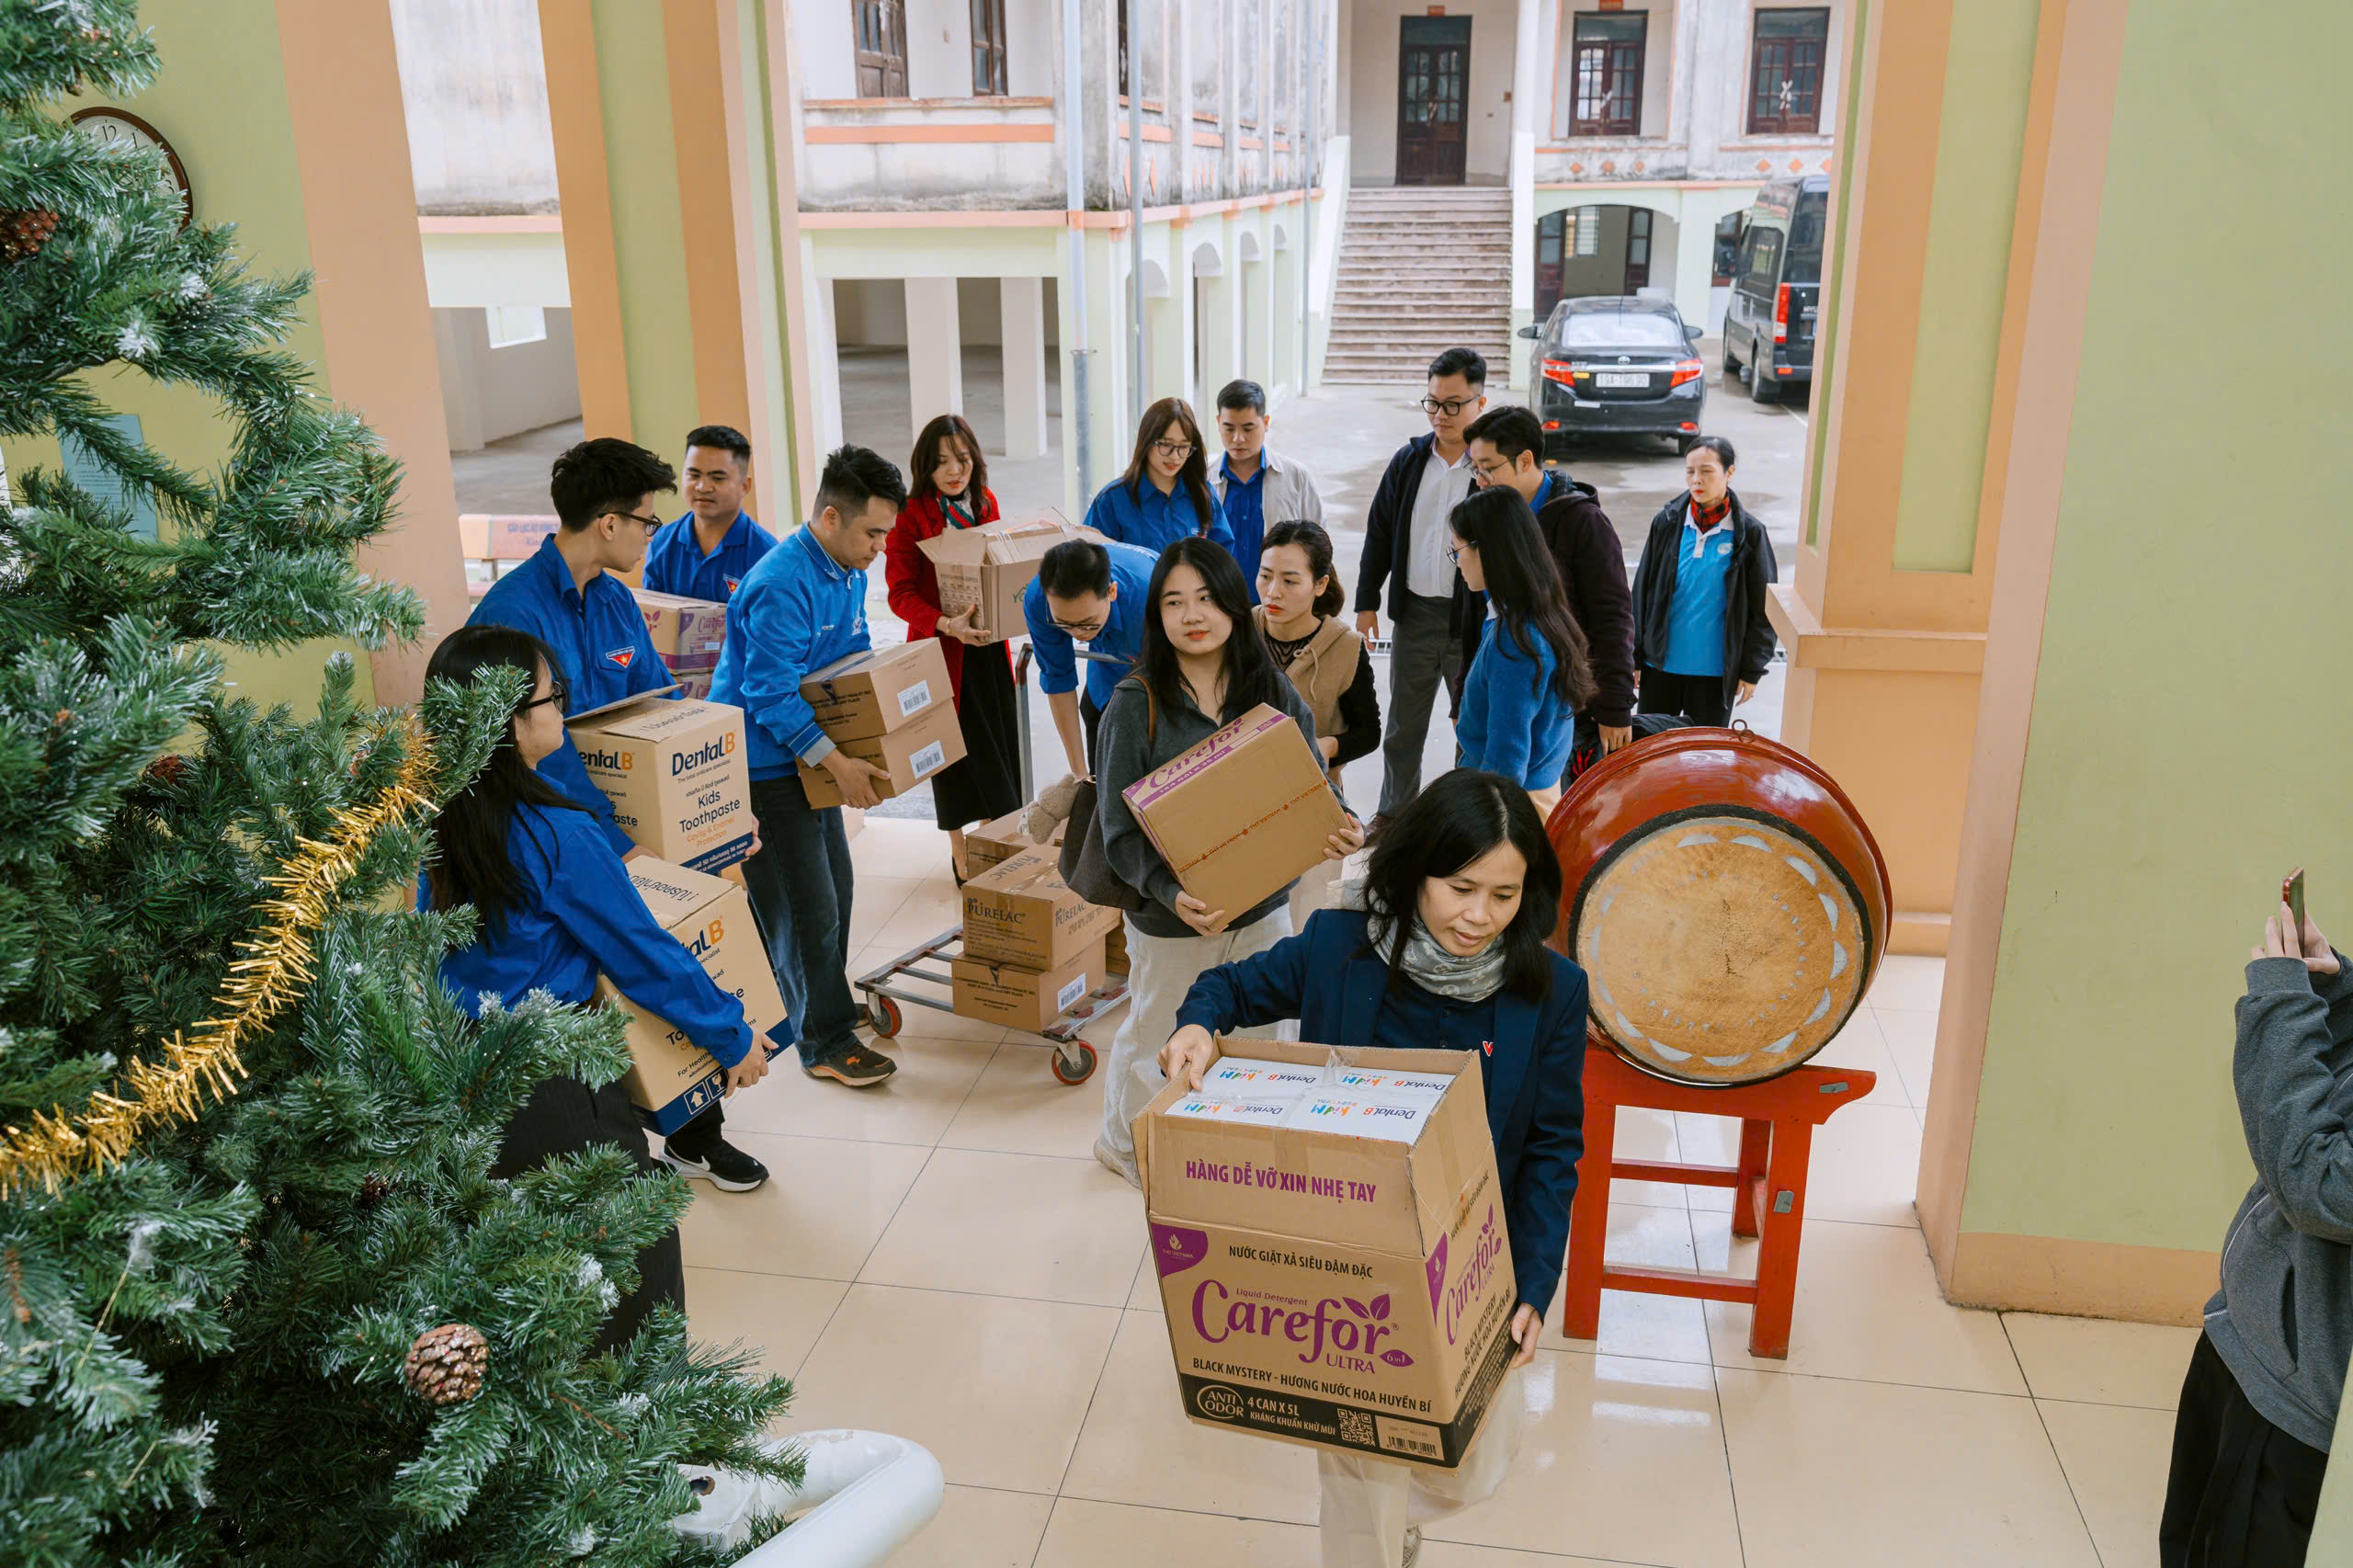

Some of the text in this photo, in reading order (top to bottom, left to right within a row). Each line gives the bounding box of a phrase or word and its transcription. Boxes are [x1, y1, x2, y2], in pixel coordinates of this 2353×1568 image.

[578, 749, 633, 770] entalB
[1150, 722, 1244, 789] Carefor
[698, 790, 721, 810] Kids
[679, 799, 741, 833] Toothpaste
[697, 830, 727, 847] Protection
[699, 948, 721, 965] pecialist
[676, 1066, 688, 1078] For
[689, 1051, 711, 1069] Health
[1186, 1159, 1377, 1203] HÀNG DỄ VỠ XIN NHẸ TAY
[1229, 1245, 1373, 1279] NƯỚC GIẶT XẢ SIÊU ĐẬM ĐẶC
[1236, 1288, 1308, 1307] Liquid Detergent
[1192, 1279, 1391, 1363] Carefor
[1325, 1352, 1376, 1374] ULTRA
[1192, 1358, 1224, 1374] BLACK
[1225, 1363, 1272, 1382] MYSTERY
[1280, 1374, 1319, 1392] HƯƠNG
[1322, 1380, 1351, 1398] NƯỚC
[1353, 1388, 1377, 1403] HOA
[1379, 1391, 1416, 1410] HUYỀN
[1419, 1399, 1432, 1413] BÍ
[1204, 1400, 1245, 1418] ODOR
[1207, 1392, 1236, 1404] ANTI
[1247, 1396, 1300, 1416] 4 CAN X 5L
[1250, 1410, 1336, 1436] KHÁNG KHUẨN KHỬ MÙI
